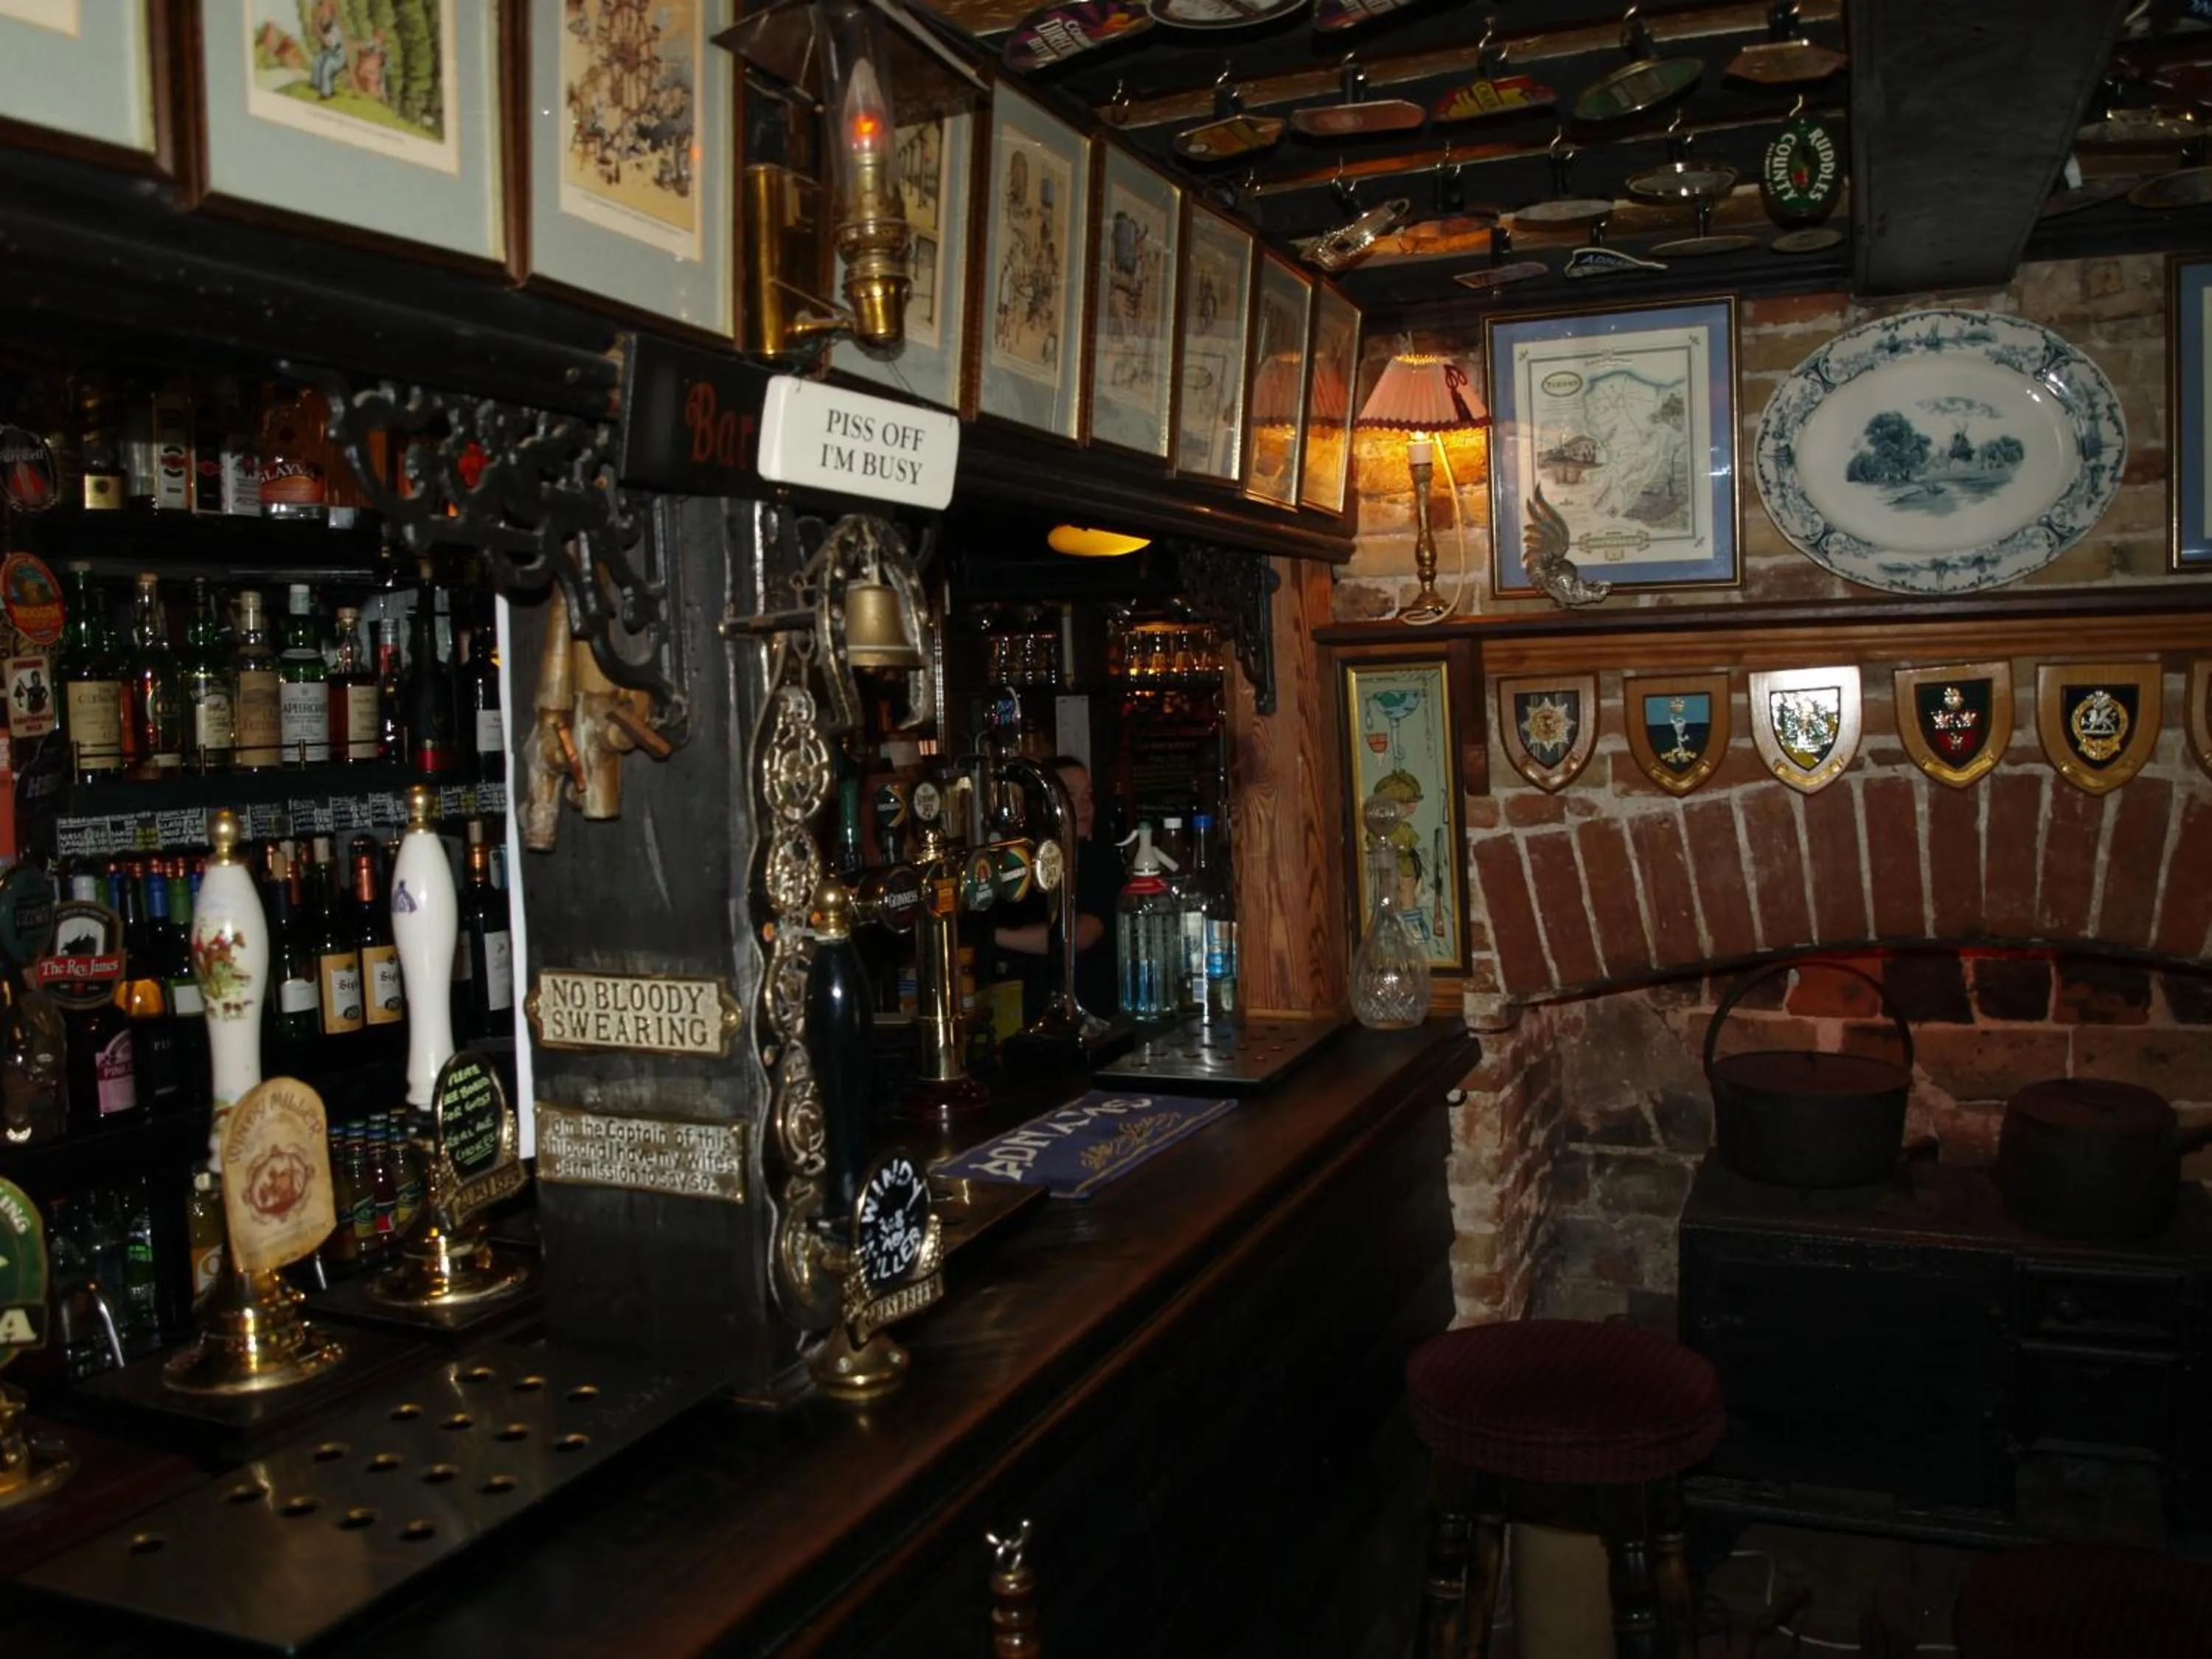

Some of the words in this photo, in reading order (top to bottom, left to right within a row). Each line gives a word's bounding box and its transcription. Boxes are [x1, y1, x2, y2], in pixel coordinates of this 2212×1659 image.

[1772, 133, 1798, 201] COUNTY
[1808, 127, 1836, 201] RUDDLES
[684, 381, 754, 470] Bar
[826, 408, 876, 442] PISS
[882, 422, 927, 452] OFF
[821, 442, 855, 473] I'M
[861, 451, 924, 486] BUSY
[41, 960, 64, 977] The
[552, 978, 586, 1009] NO
[594, 981, 704, 1015] BLOODY
[553, 1010, 708, 1046] SWEARING
[606, 1119, 666, 1145] Captain
[676, 1127, 693, 1146] of
[698, 1126, 731, 1150] this
[968, 1097, 1153, 1181] ADNAMS
[0, 1187, 32, 1235] ING
[860, 1158, 928, 1224] WINDY
